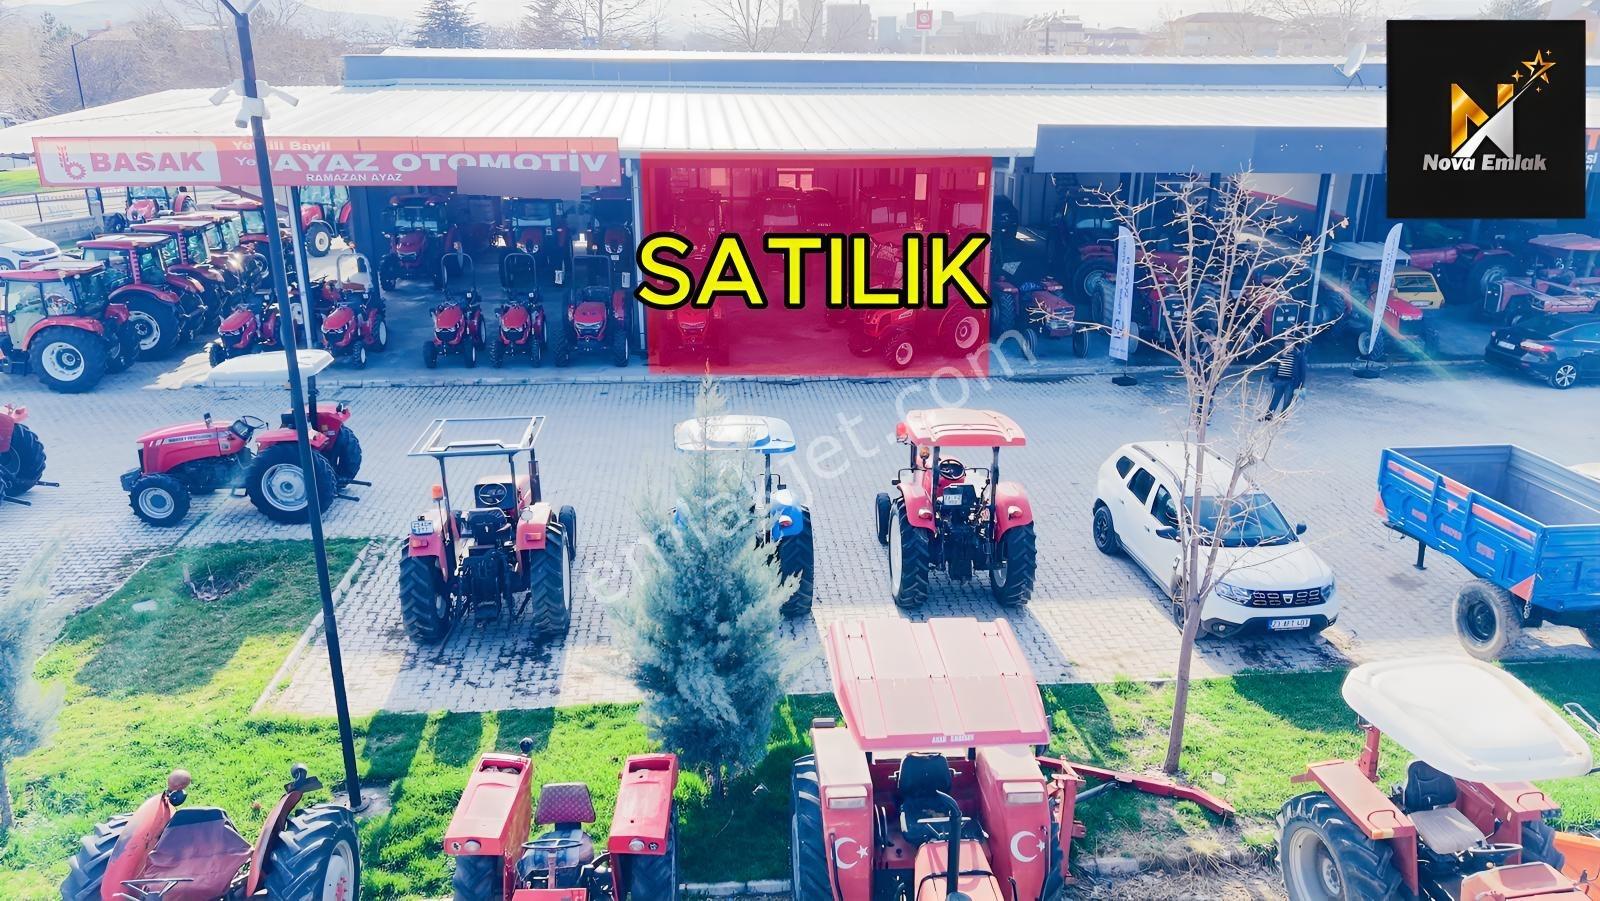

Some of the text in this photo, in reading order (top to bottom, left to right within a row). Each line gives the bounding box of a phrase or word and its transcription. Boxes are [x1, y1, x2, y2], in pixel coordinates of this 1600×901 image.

[232, 140, 285, 151] Yeili
[90, 151, 204, 172] BASAK
[273, 153, 379, 172] AYAZ
[392, 149, 608, 172] OTOMOTİV
[306, 173, 402, 182] RAMAZAN AYAZ
